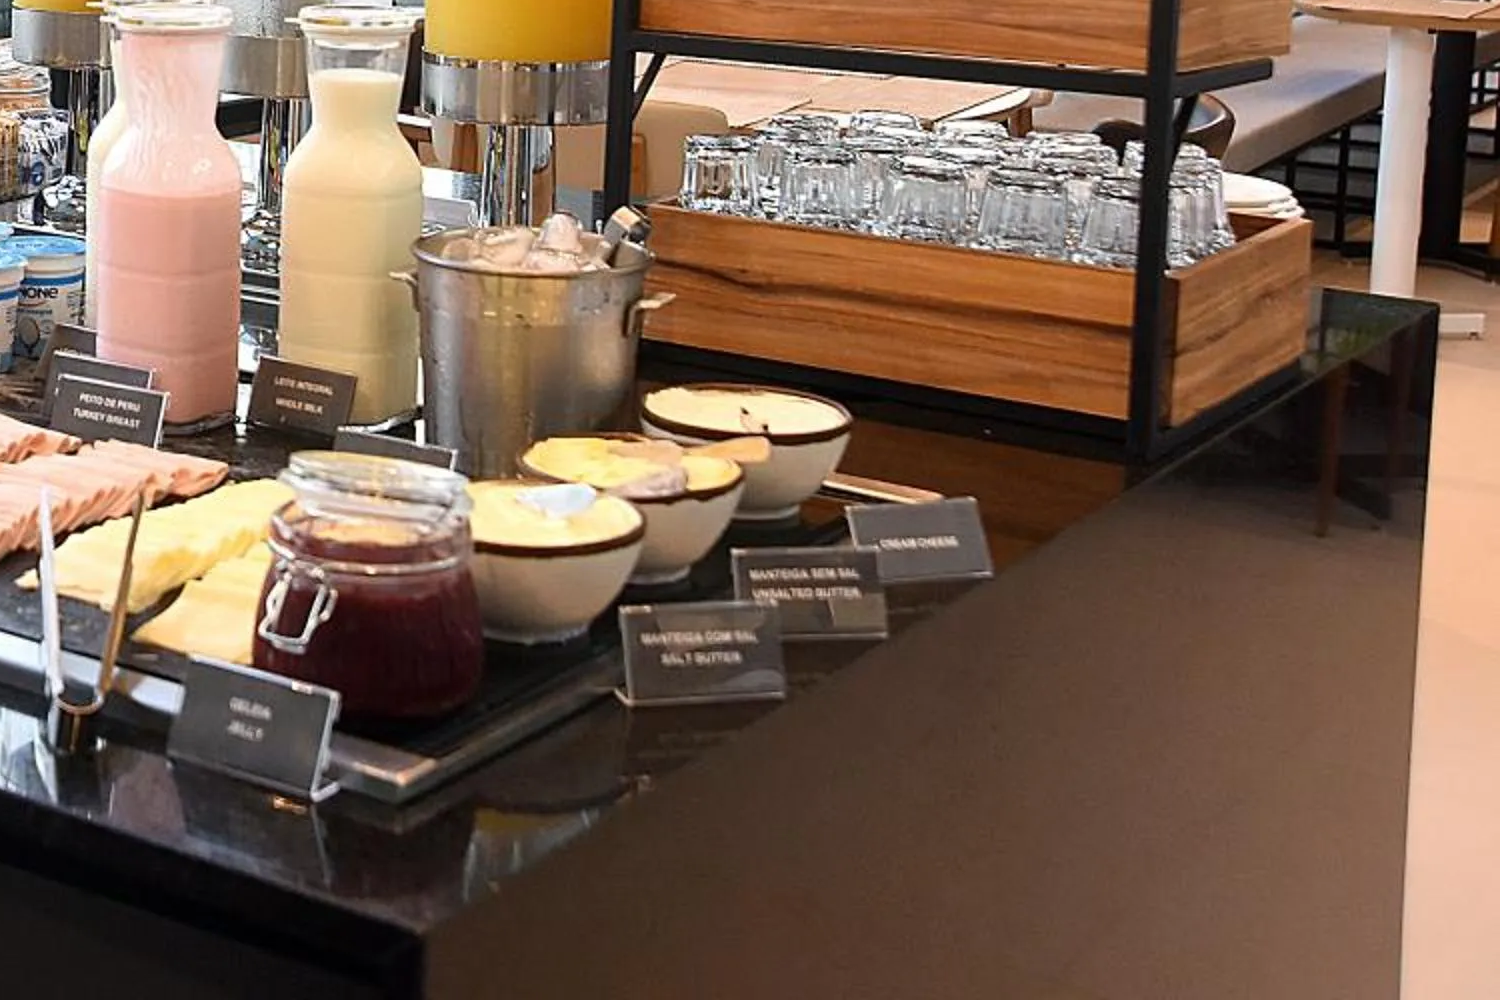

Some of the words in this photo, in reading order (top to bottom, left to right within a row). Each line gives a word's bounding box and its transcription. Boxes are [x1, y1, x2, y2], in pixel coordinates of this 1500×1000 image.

[73, 407, 105, 422] TURKEY
[749, 567, 809, 581] MANTEIGA
[751, 587, 813, 600] UNSALTED
[815, 586, 862, 600] BUTTER
[694, 651, 743, 666] BUTTER
